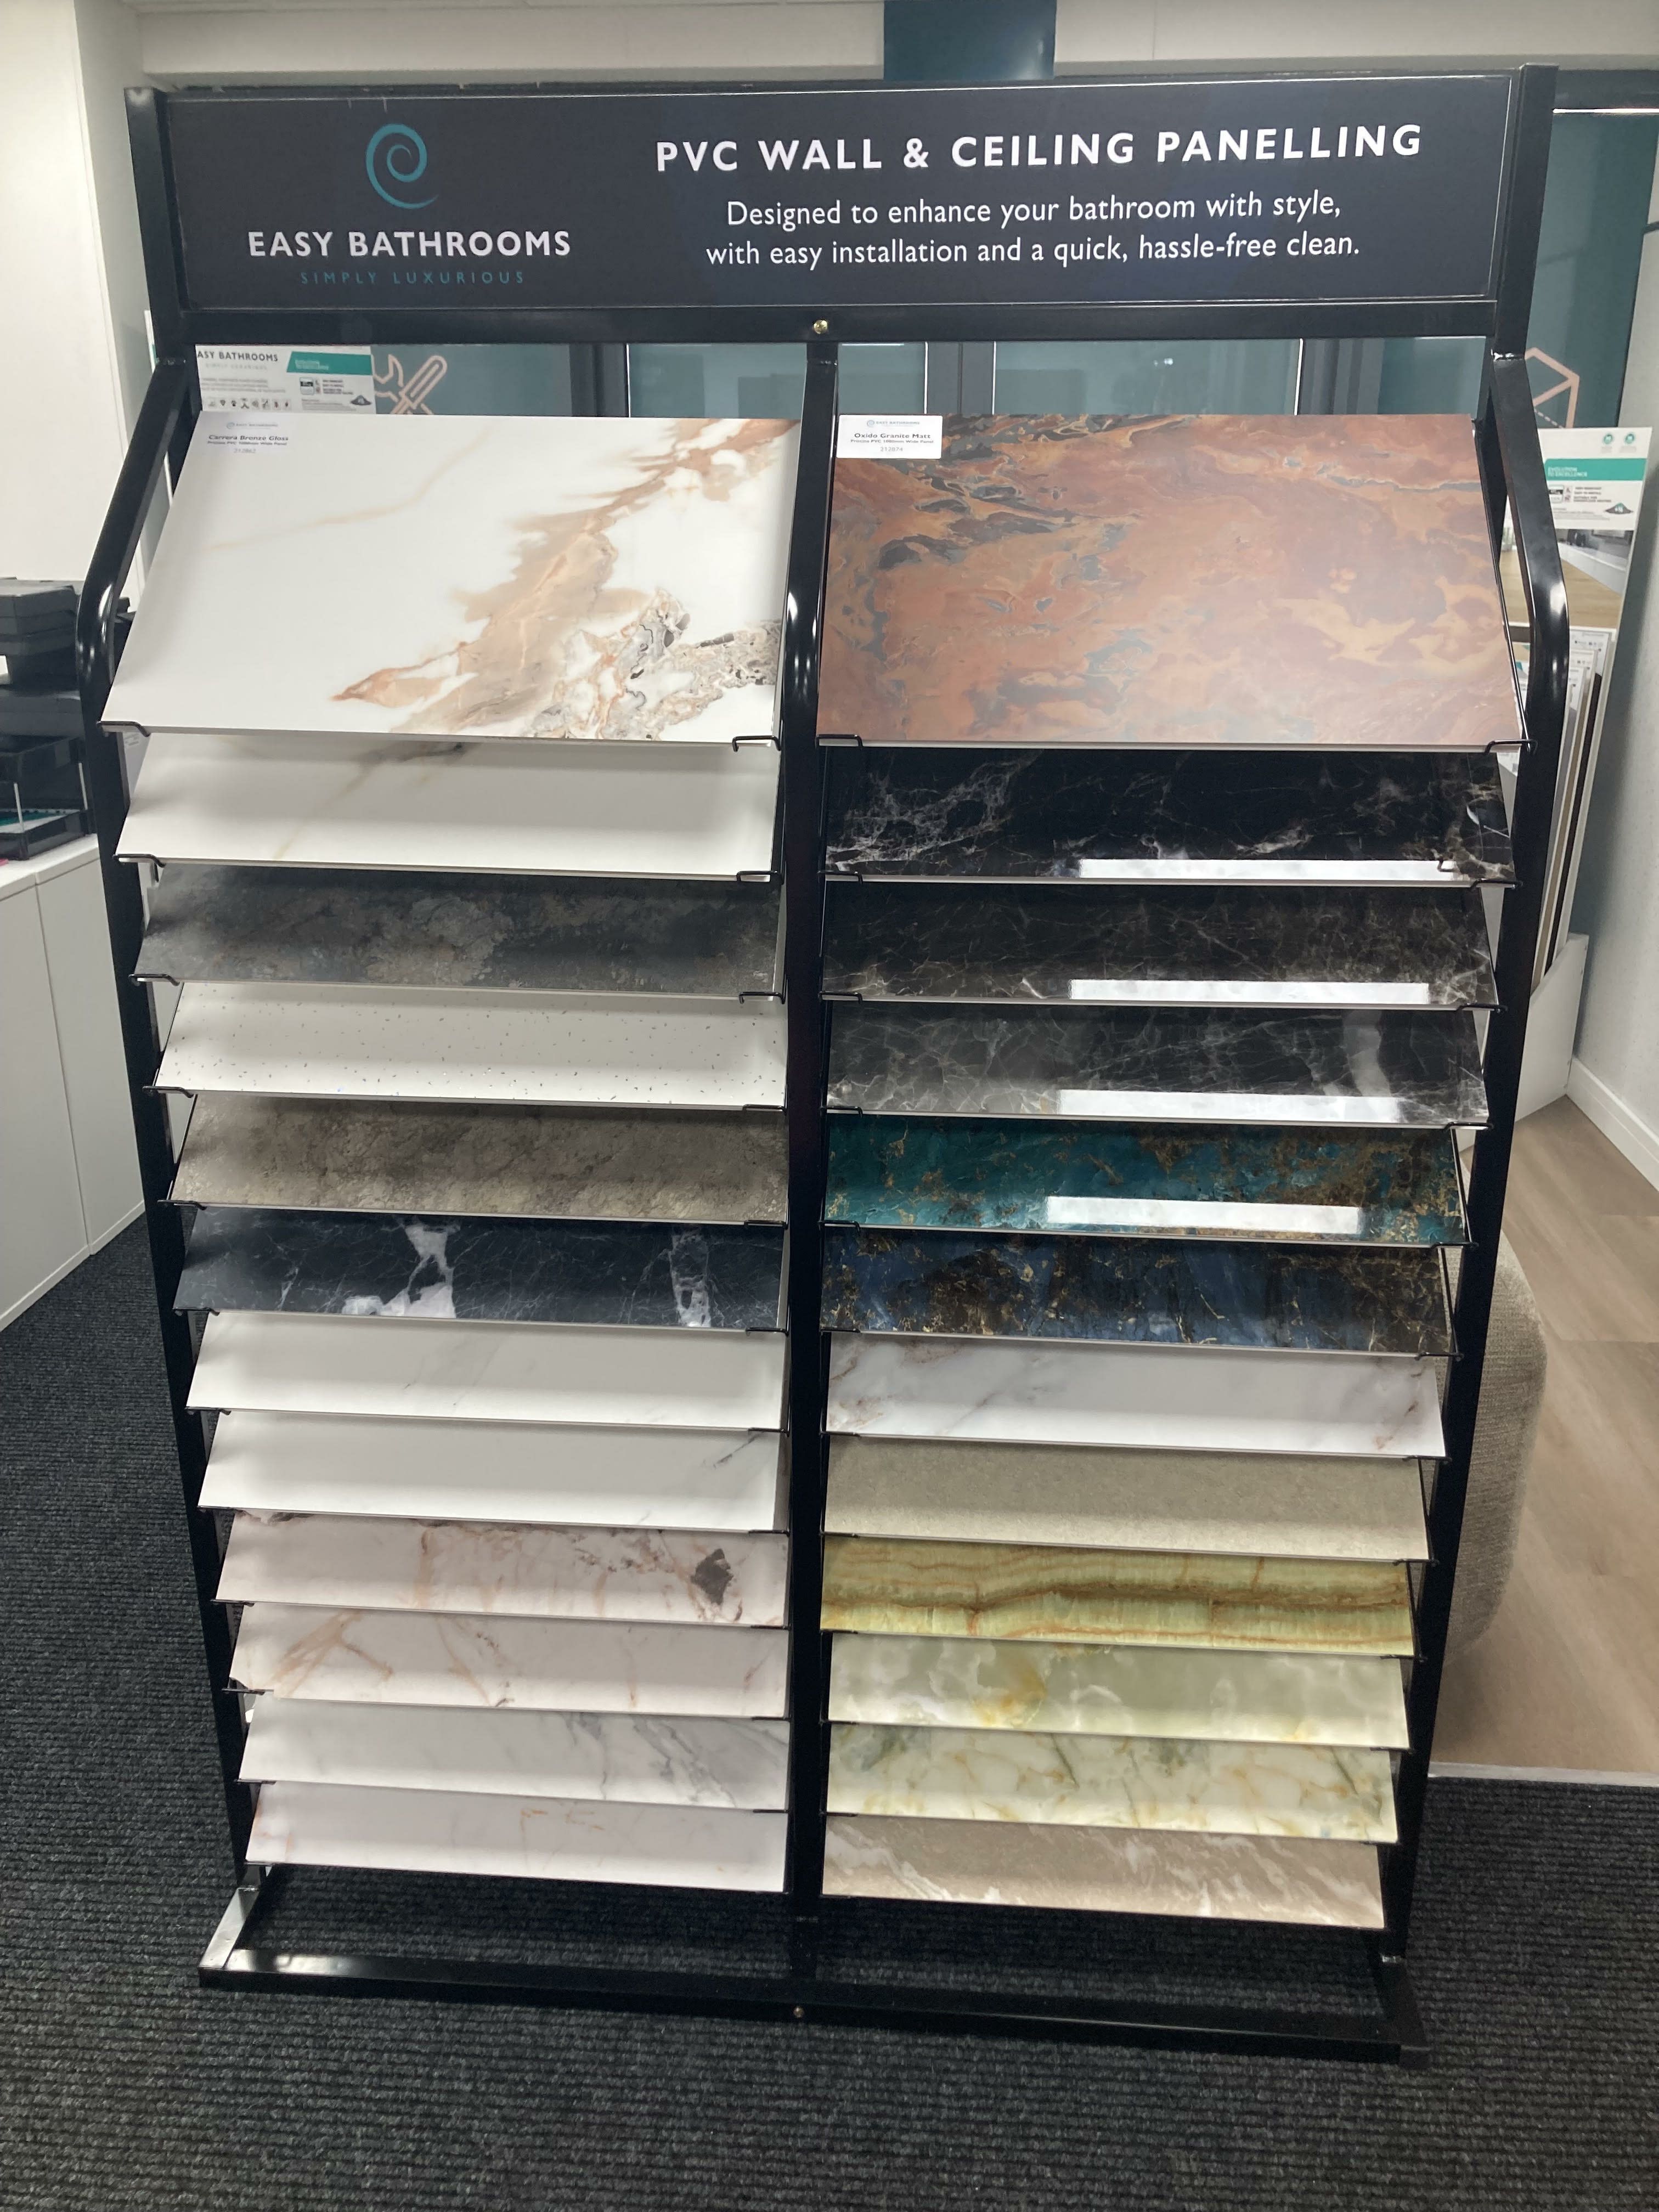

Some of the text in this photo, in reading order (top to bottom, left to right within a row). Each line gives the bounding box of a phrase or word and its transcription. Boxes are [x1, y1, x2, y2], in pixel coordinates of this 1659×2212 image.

[656, 123, 1421, 172] PVC WALL & CEILING PANELLING
[727, 188, 1341, 233] Designed to enhance your bathroom with style,
[247, 230, 571, 257] EASY BATHROOMS
[706, 229, 1360, 272] with easy installation and a quick, hassle-free clean.
[301, 270, 524, 285] SIMPLY LUXURIOUS
[196, 351, 278, 362] ASY BATHROOMS
